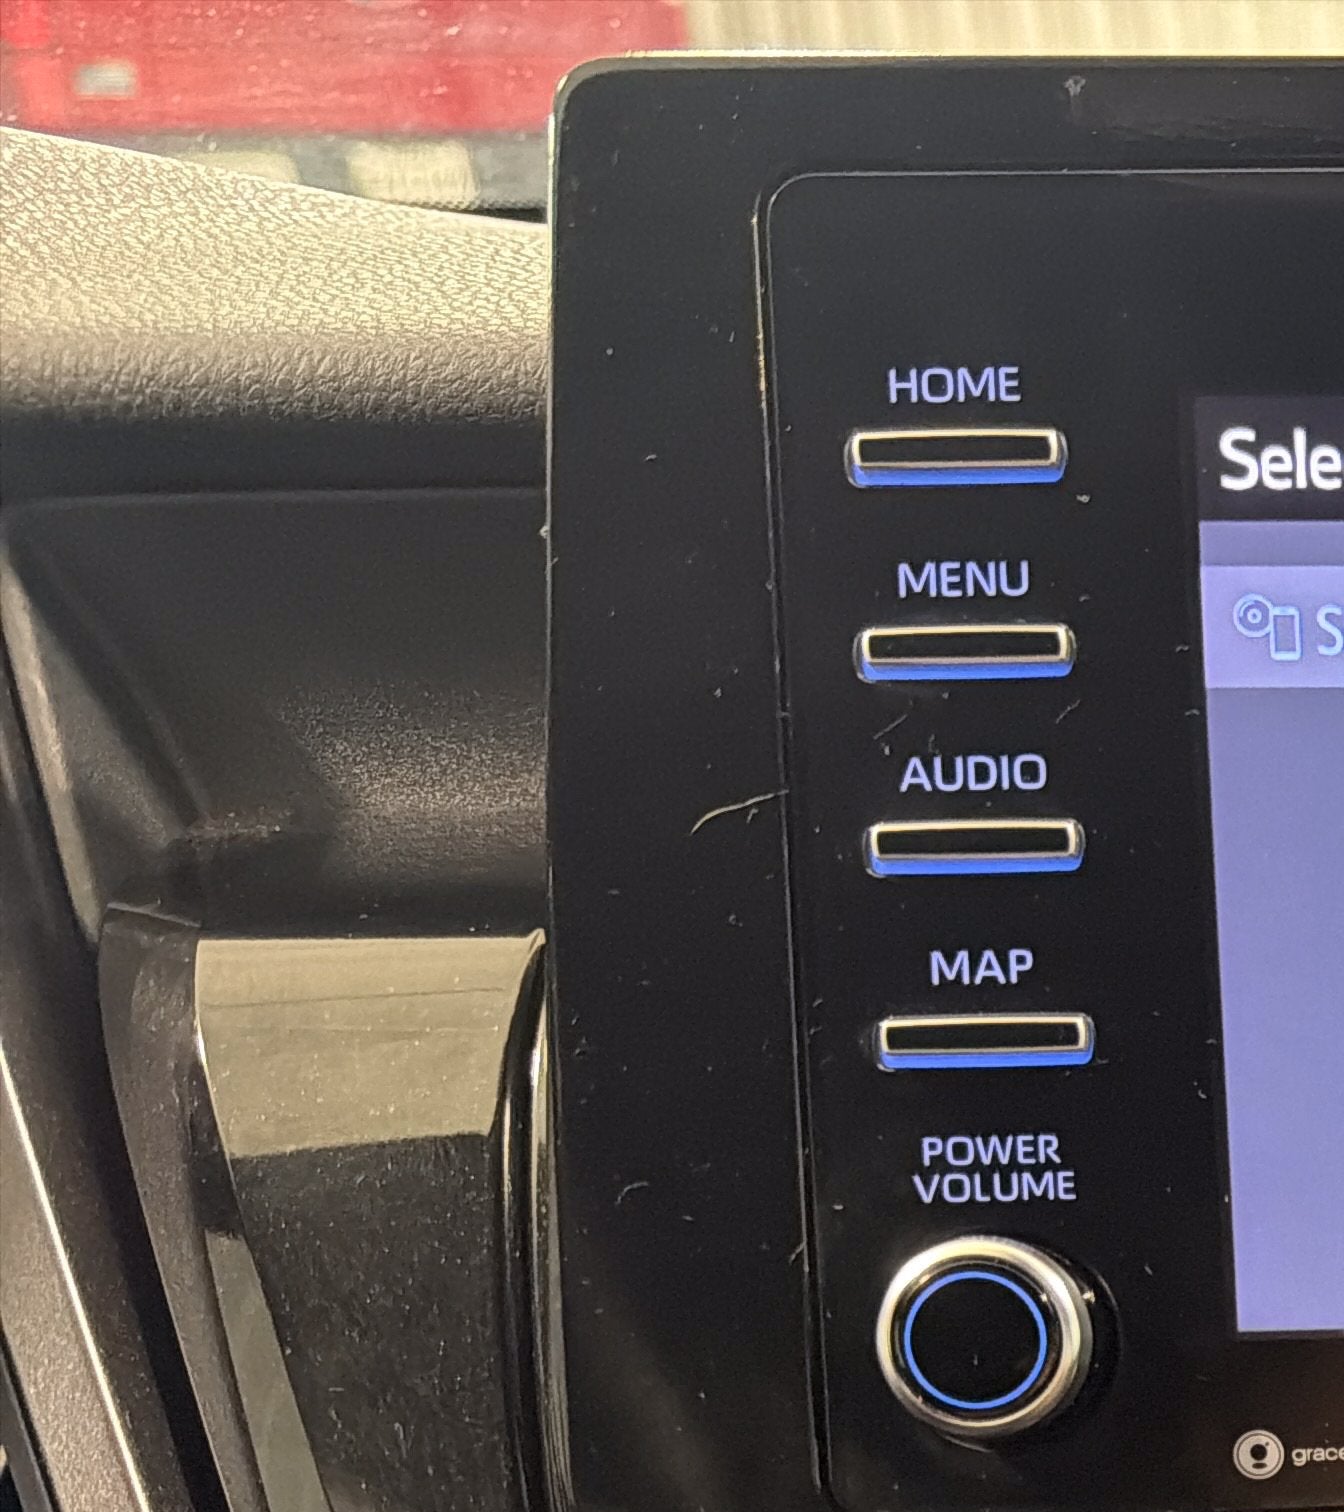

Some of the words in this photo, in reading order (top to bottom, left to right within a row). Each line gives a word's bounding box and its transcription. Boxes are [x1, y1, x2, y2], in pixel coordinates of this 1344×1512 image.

[888, 366, 1021, 404] HOME
[897, 560, 1029, 599] MENU
[899, 753, 1047, 793] AUDIO
[930, 948, 1034, 986] MAP
[921, 1134, 1062, 1167] POWER
[912, 1171, 1077, 1204] VOLUME
